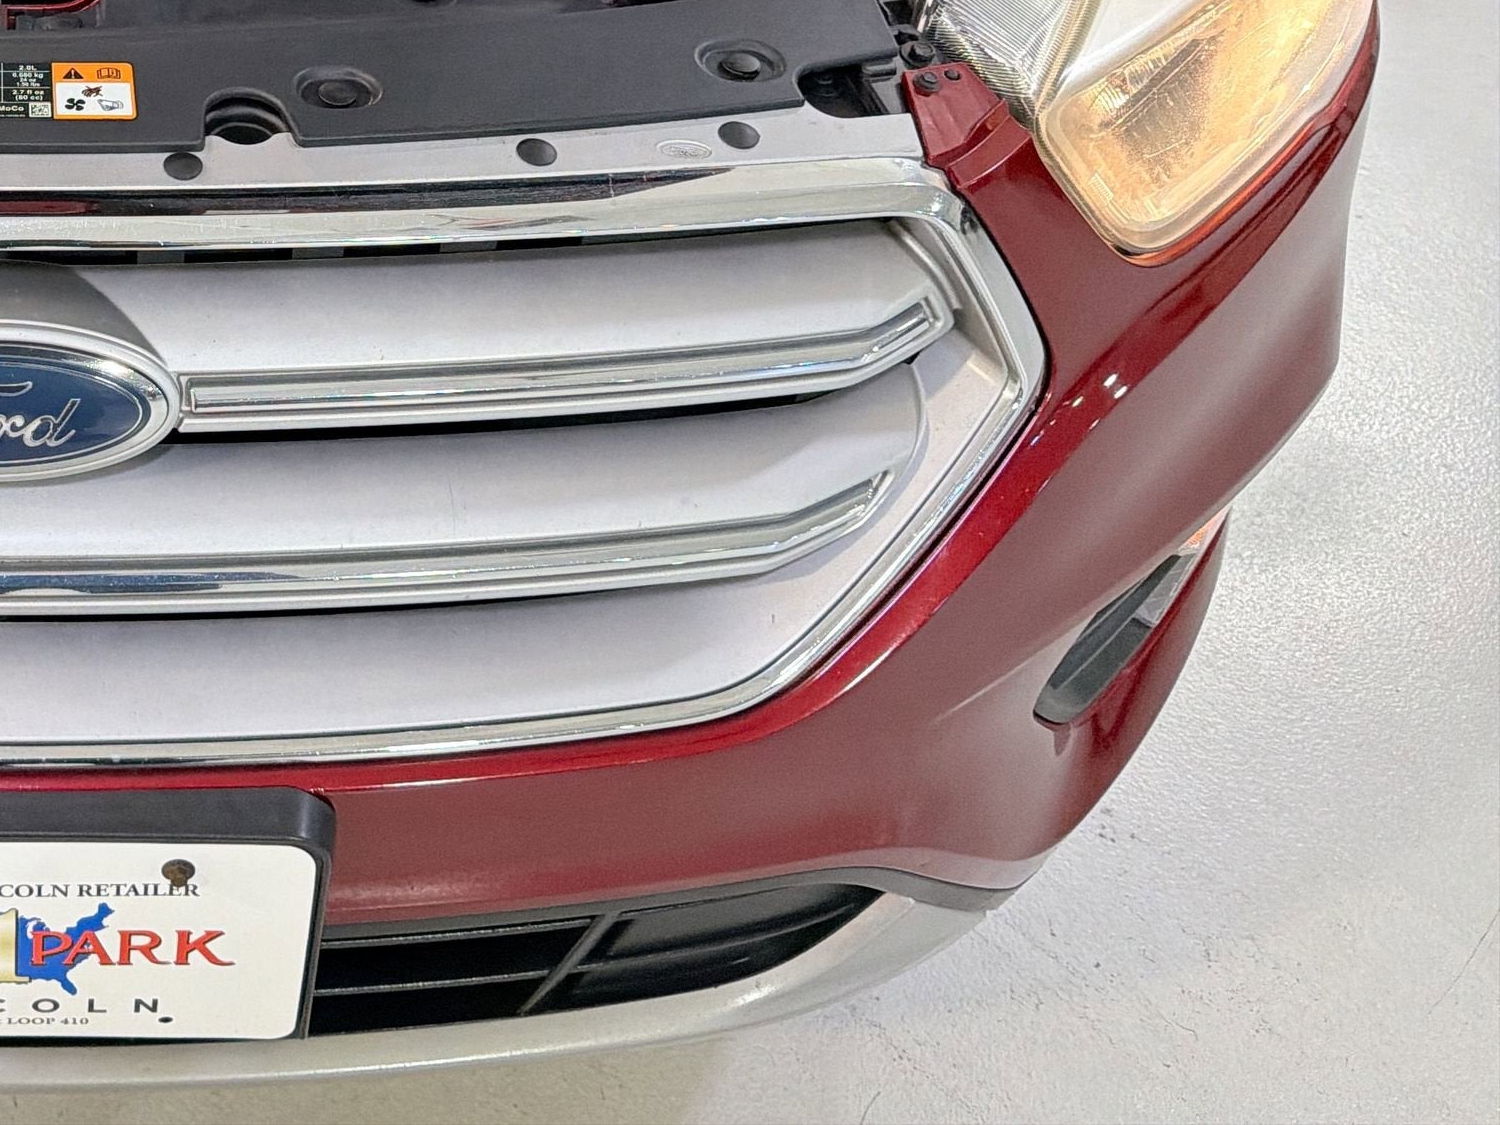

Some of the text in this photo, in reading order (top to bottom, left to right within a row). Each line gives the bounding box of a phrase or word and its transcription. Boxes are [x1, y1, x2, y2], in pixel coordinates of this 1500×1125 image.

[76, 882, 201, 897] RETAILER
[31, 929, 236, 967] PARK
[7, 1017, 56, 1025] LOOP
[59, 1017, 90, 1025] 410
